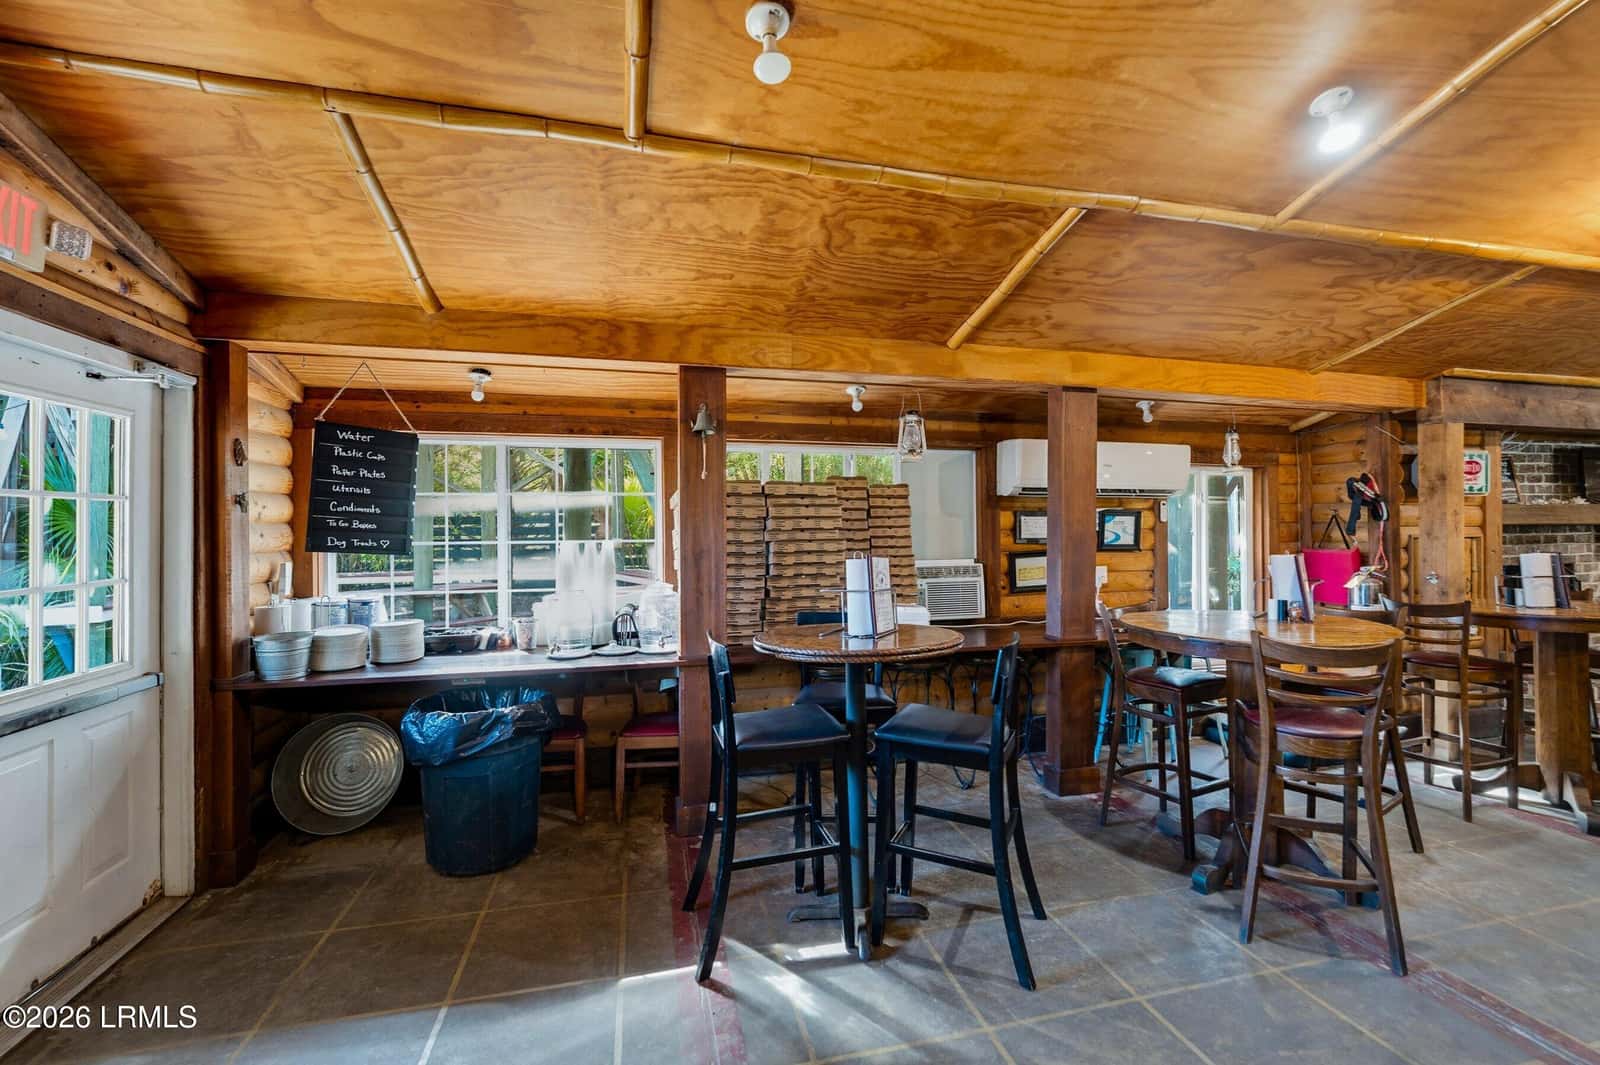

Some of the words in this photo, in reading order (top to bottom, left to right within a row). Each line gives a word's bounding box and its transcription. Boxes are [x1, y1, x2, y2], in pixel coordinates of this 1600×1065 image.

[336, 430, 375, 442] Water
[333, 446, 363, 459] Plastic
[366, 451, 386, 461] Cups
[359, 467, 386, 479] Plates
[329, 501, 381, 514] Condiments
[326, 519, 337, 527] To
[338, 519, 349, 527] Go
[351, 519, 377, 529] Boxes
[327, 536, 346, 548] Dog
[351, 538, 377, 548] Treats
